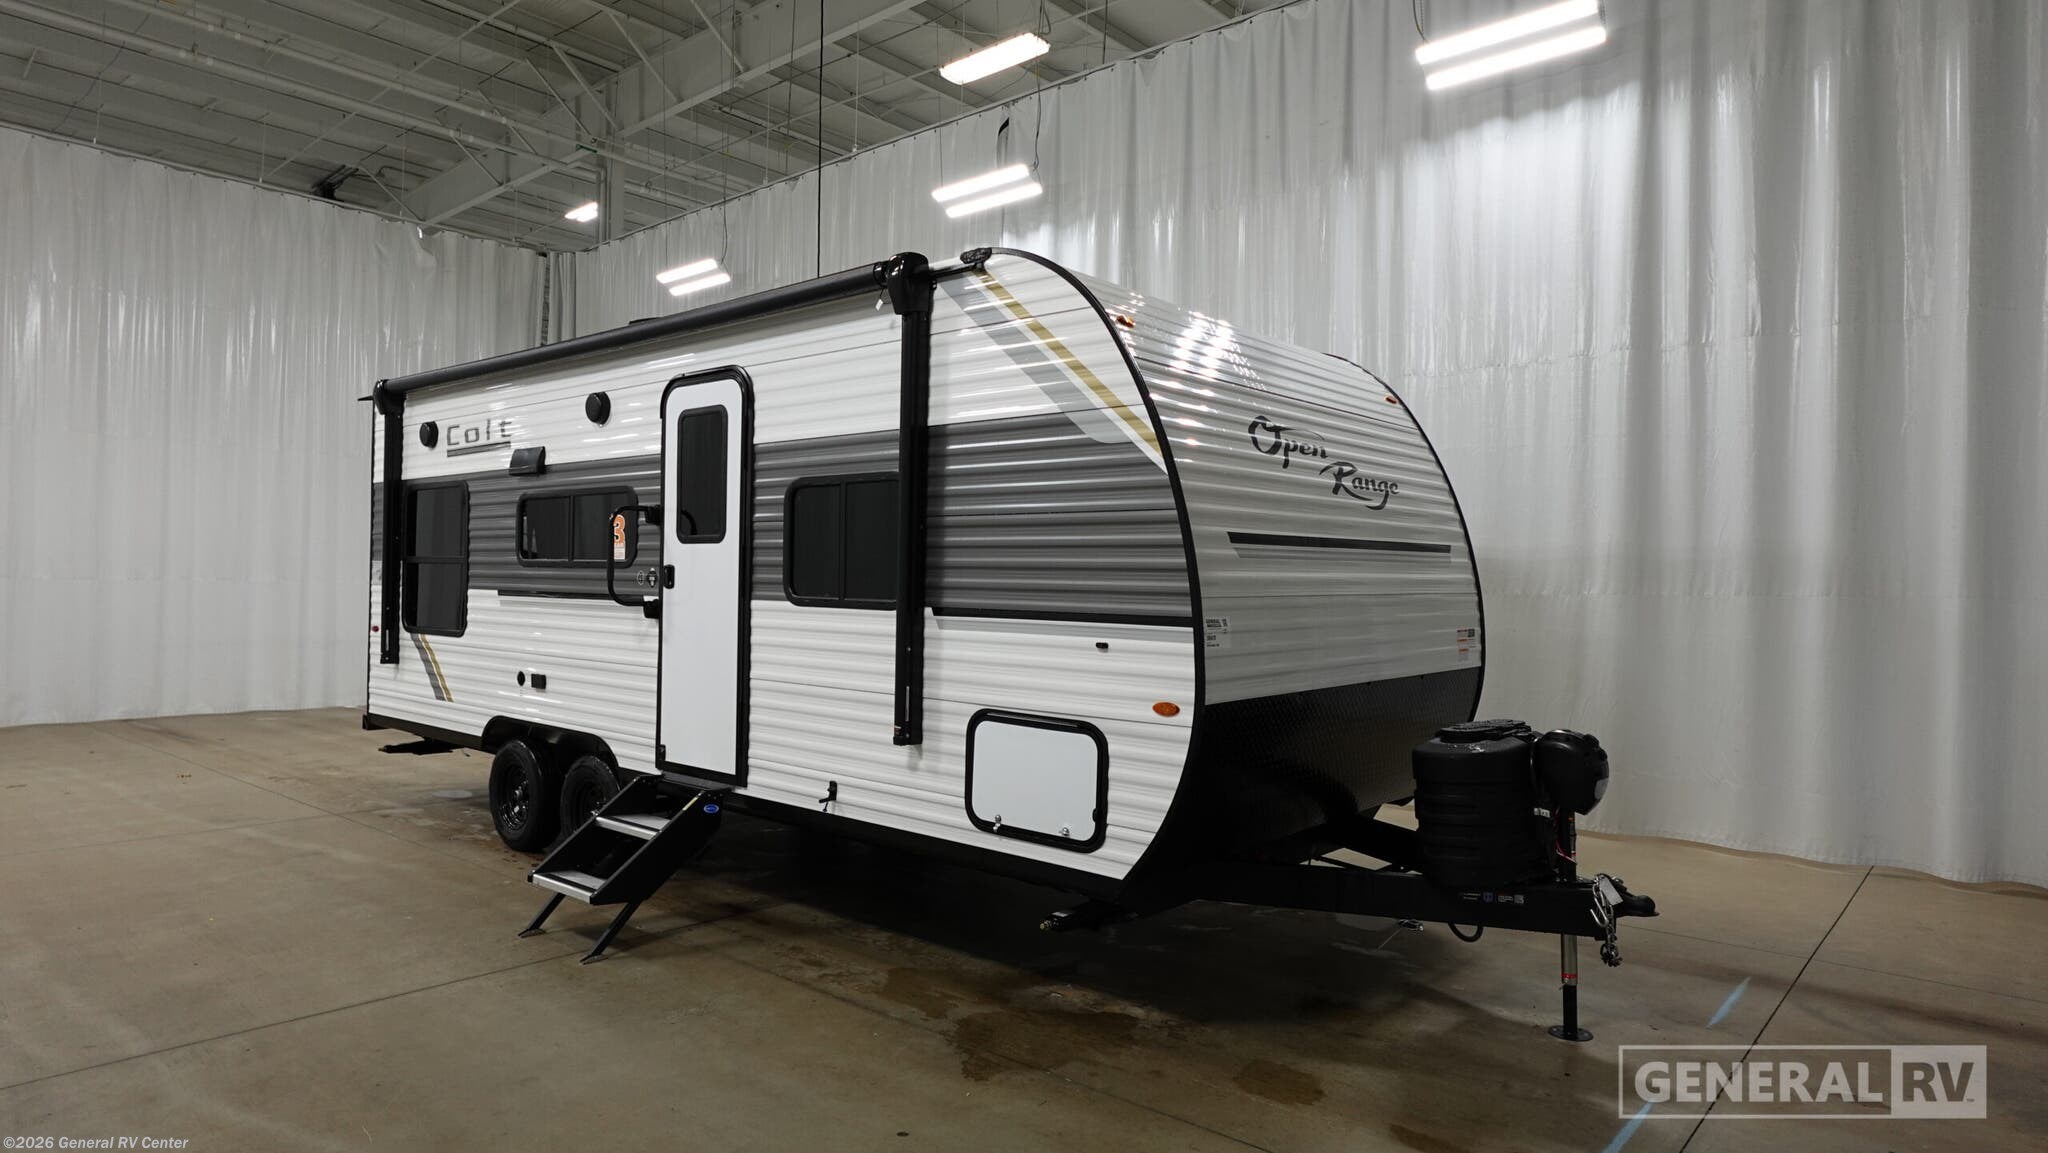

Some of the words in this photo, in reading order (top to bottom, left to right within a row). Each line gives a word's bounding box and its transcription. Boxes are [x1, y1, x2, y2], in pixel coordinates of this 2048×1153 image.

[446, 418, 512, 446] Colt
[1248, 415, 1329, 469] Open
[1319, 461, 1399, 510] Range
